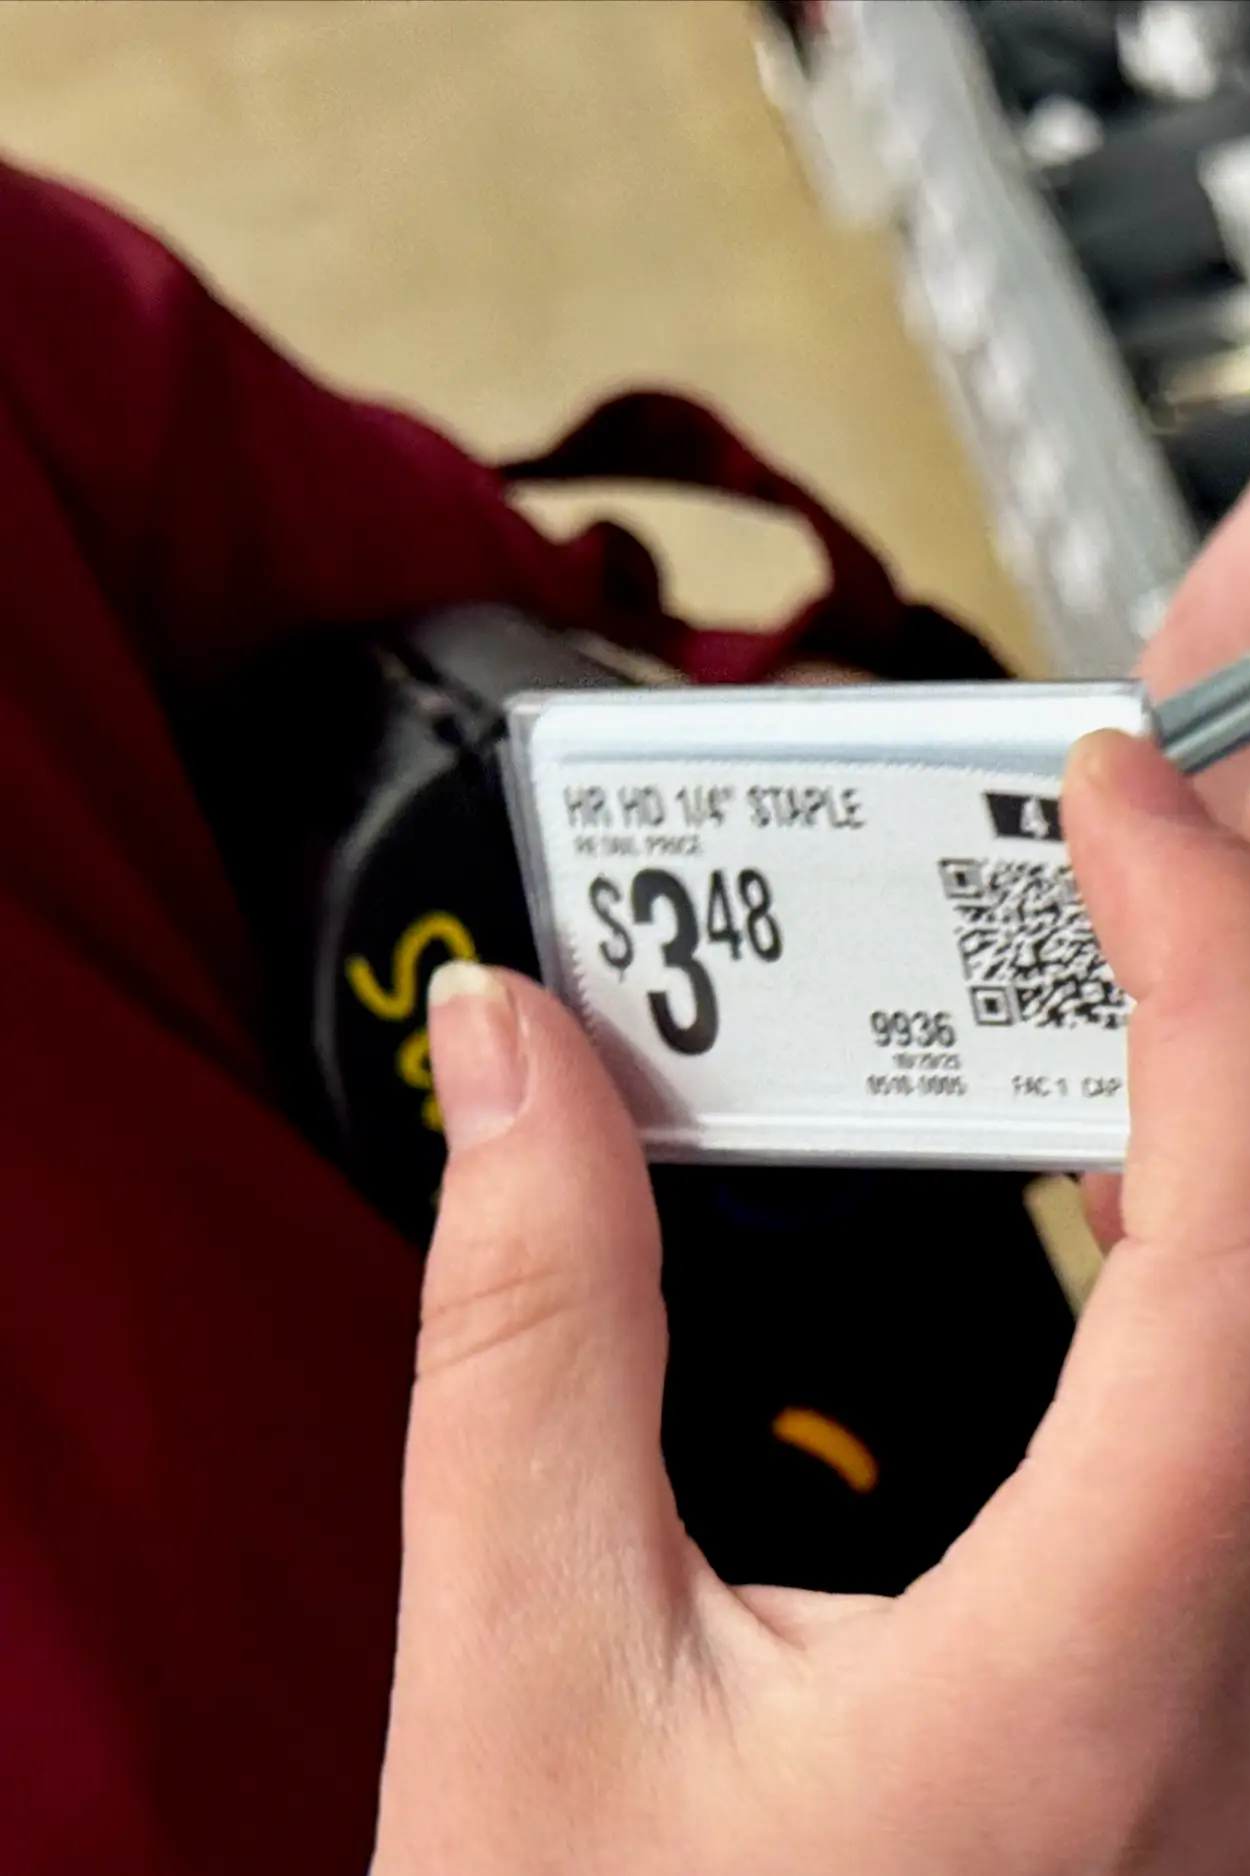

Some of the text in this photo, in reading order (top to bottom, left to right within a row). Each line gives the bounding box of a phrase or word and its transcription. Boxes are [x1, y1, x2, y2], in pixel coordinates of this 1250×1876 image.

[564, 785, 866, 830] HR HD 1/4" STAPLE
[1021, 796, 1050, 838] 4
[868, 1010, 956, 1048] 9936
[1011, 1075, 1051, 1096] FAC
[1081, 1076, 1123, 1097] CAP
